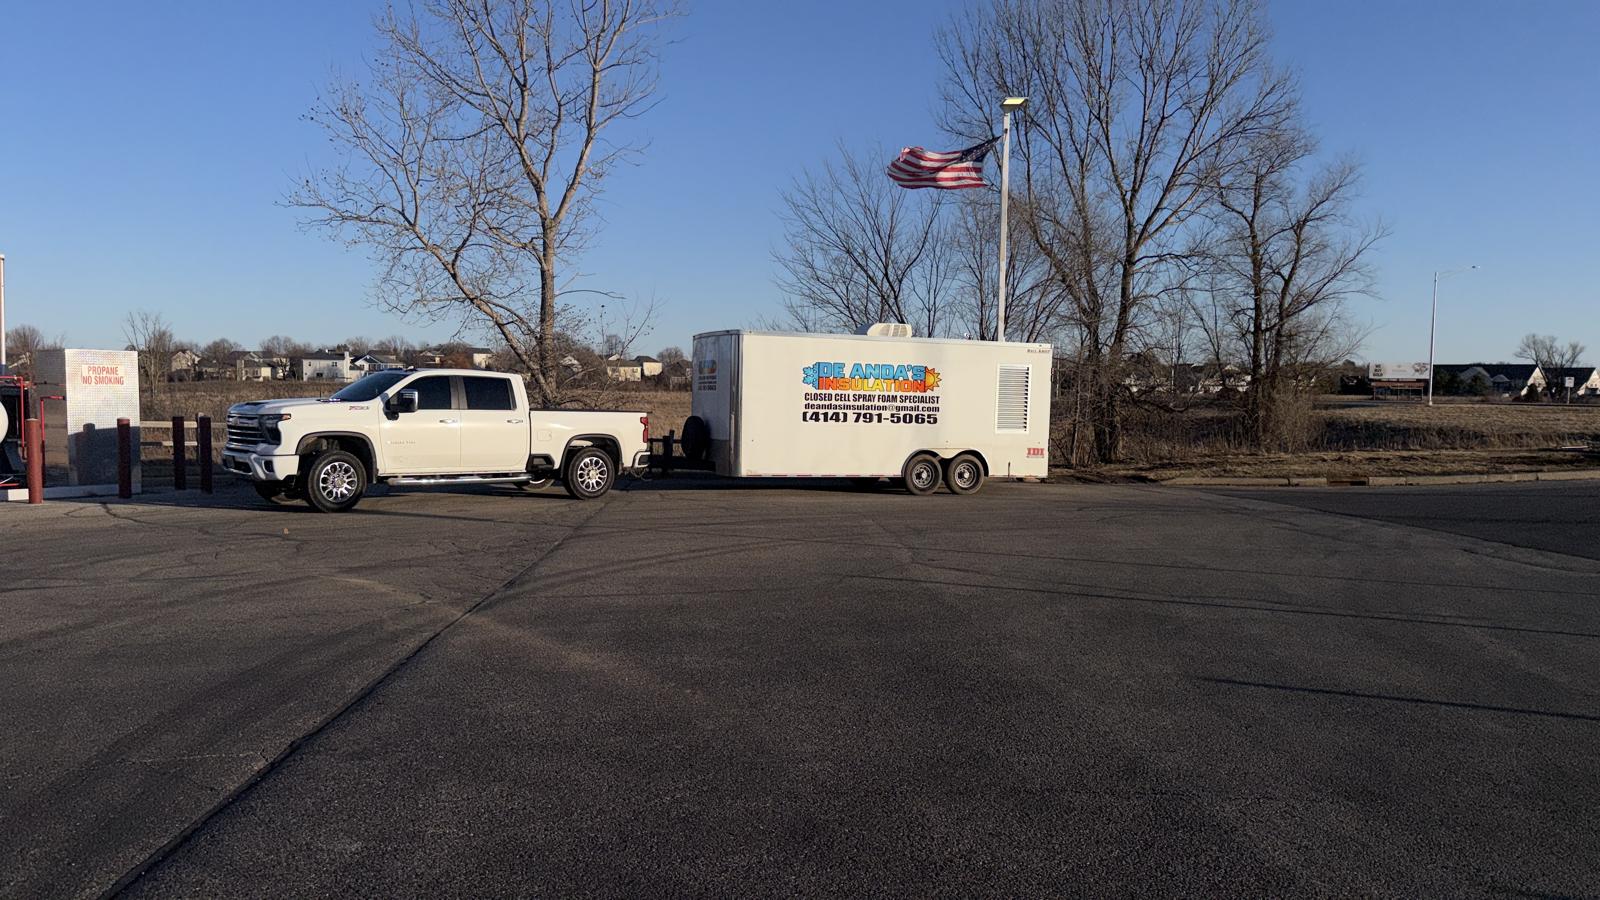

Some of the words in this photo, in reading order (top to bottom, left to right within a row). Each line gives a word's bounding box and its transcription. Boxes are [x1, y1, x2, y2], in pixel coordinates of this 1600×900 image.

[87, 366, 119, 375] PROPANE
[817, 362, 845, 378] DE
[849, 363, 926, 380] ANDA'S
[82, 376, 92, 384] NO
[94, 376, 124, 385] SMOKING
[818, 377, 926, 392] INSULATION
[804, 393, 832, 401] CLOSED
[834, 393, 850, 402] CELL
[852, 394, 876, 402] SPRAY
[878, 395, 897, 403] FOAM
[899, 395, 940, 404] SPECIALIST
[804, 403, 940, 412] deandasinsulation@gmail.com
[802, 411, 847, 422] (414)
[852, 412, 938, 424] 791-5065
